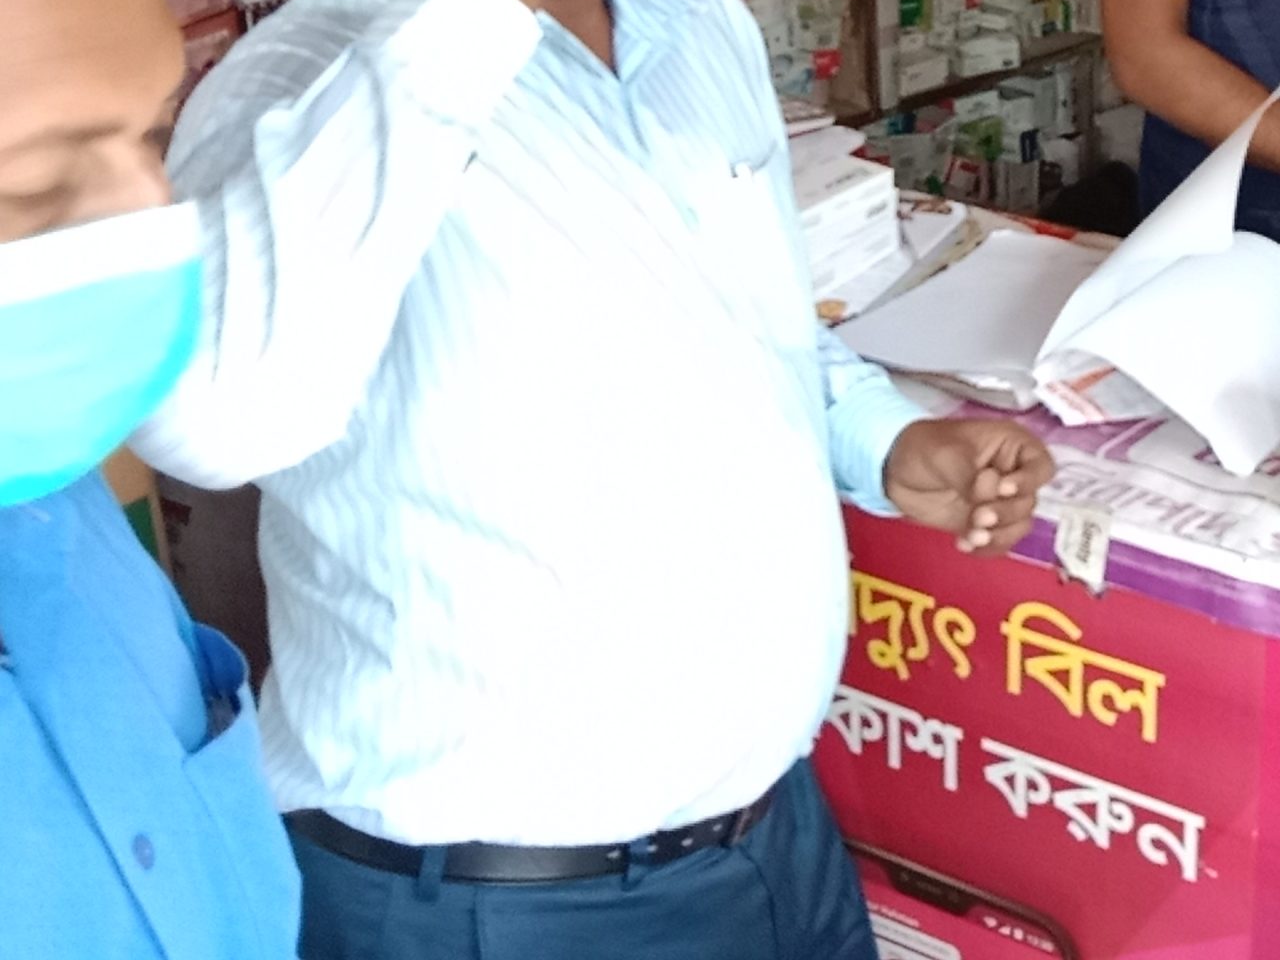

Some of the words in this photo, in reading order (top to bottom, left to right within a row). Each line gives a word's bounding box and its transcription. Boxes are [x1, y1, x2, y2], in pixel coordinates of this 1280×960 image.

[848, 569, 977, 681] দ্যুৎ
[1000, 601, 1165, 743] বিল
[827, 683, 964, 792] কাশ
[980, 736, 1206, 882] করুন
